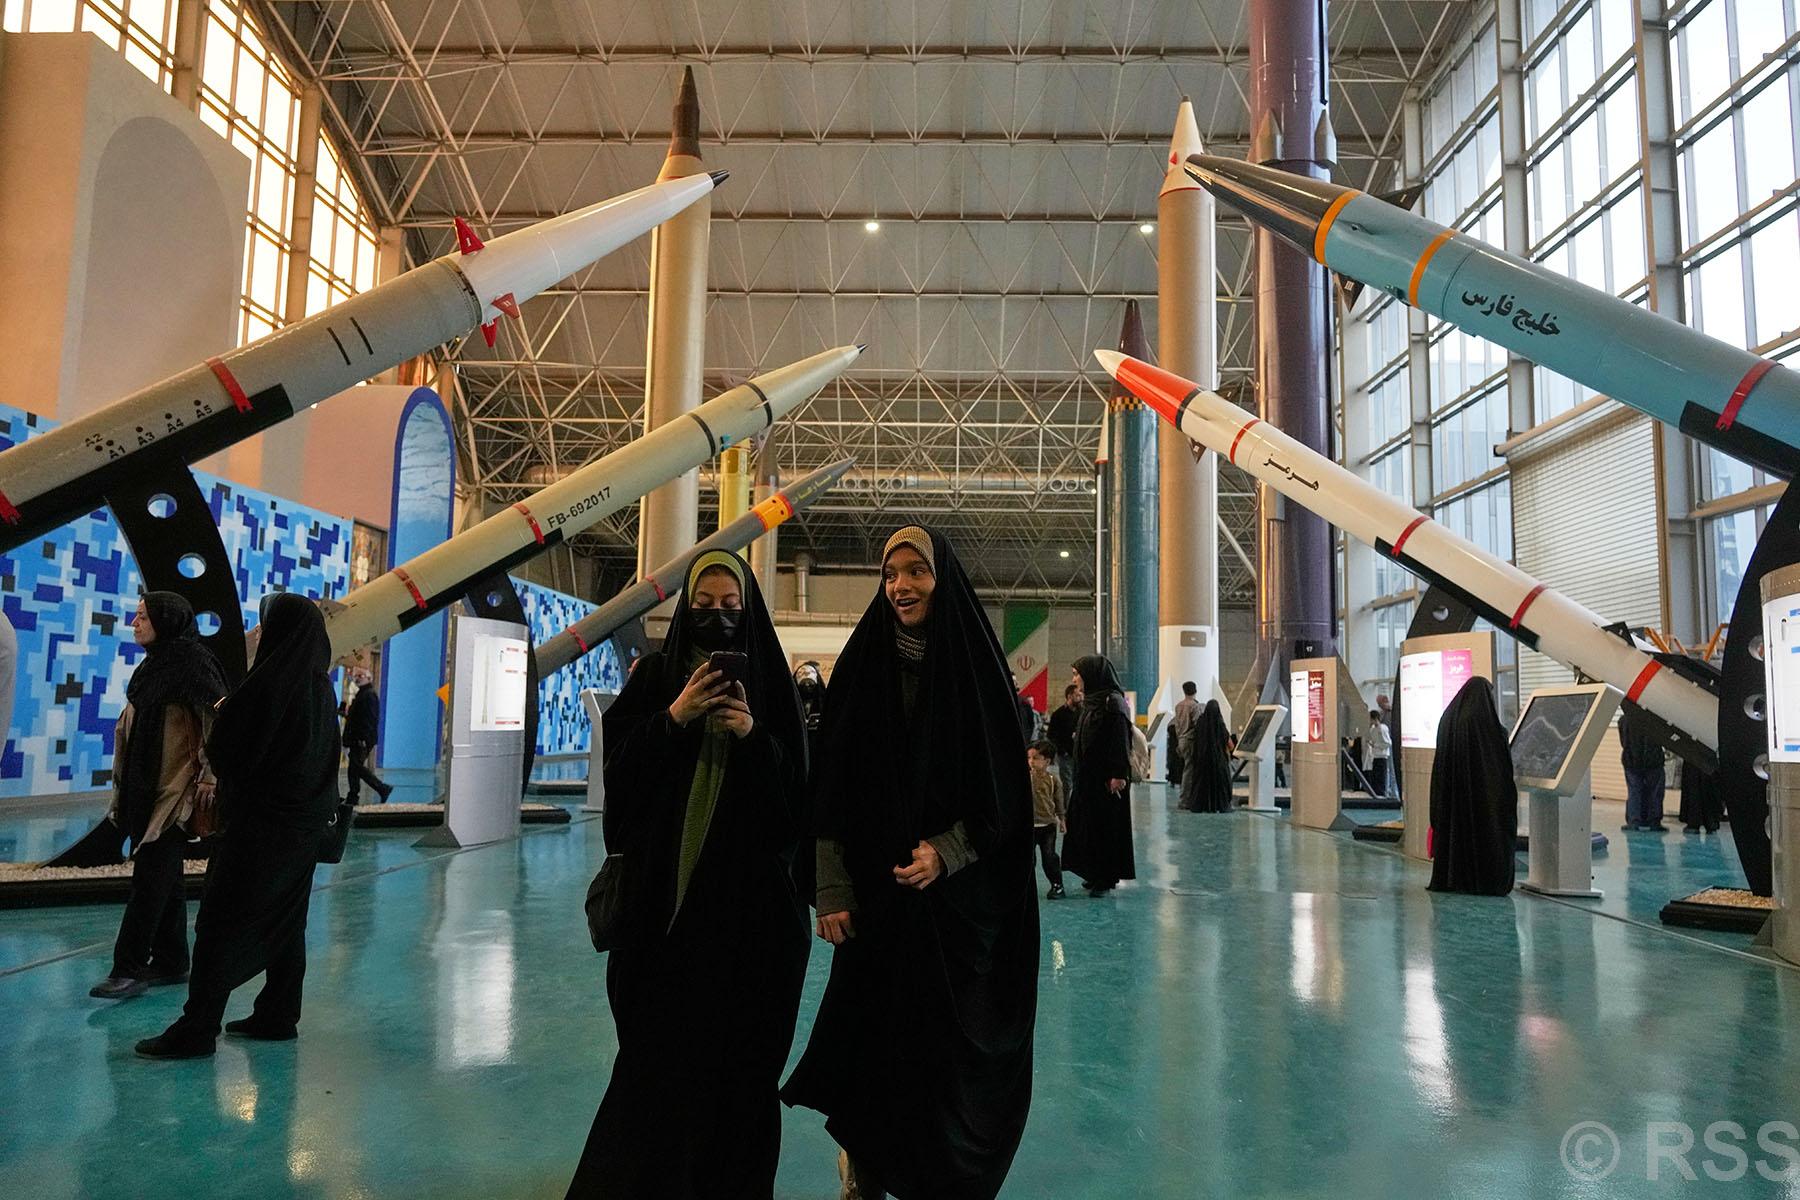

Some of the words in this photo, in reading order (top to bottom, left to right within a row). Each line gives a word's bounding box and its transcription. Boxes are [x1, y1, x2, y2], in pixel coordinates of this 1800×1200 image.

[1461, 290, 1515, 317] فارس
[1512, 308, 1560, 336] خلیج
[195, 404, 213, 419] A5
[167, 418, 184, 433] A4
[84, 432, 103, 447] A2
[137, 431, 156, 446] A3
[108, 445, 126, 459] A1
[546, 486, 611, 529] FB-692017
